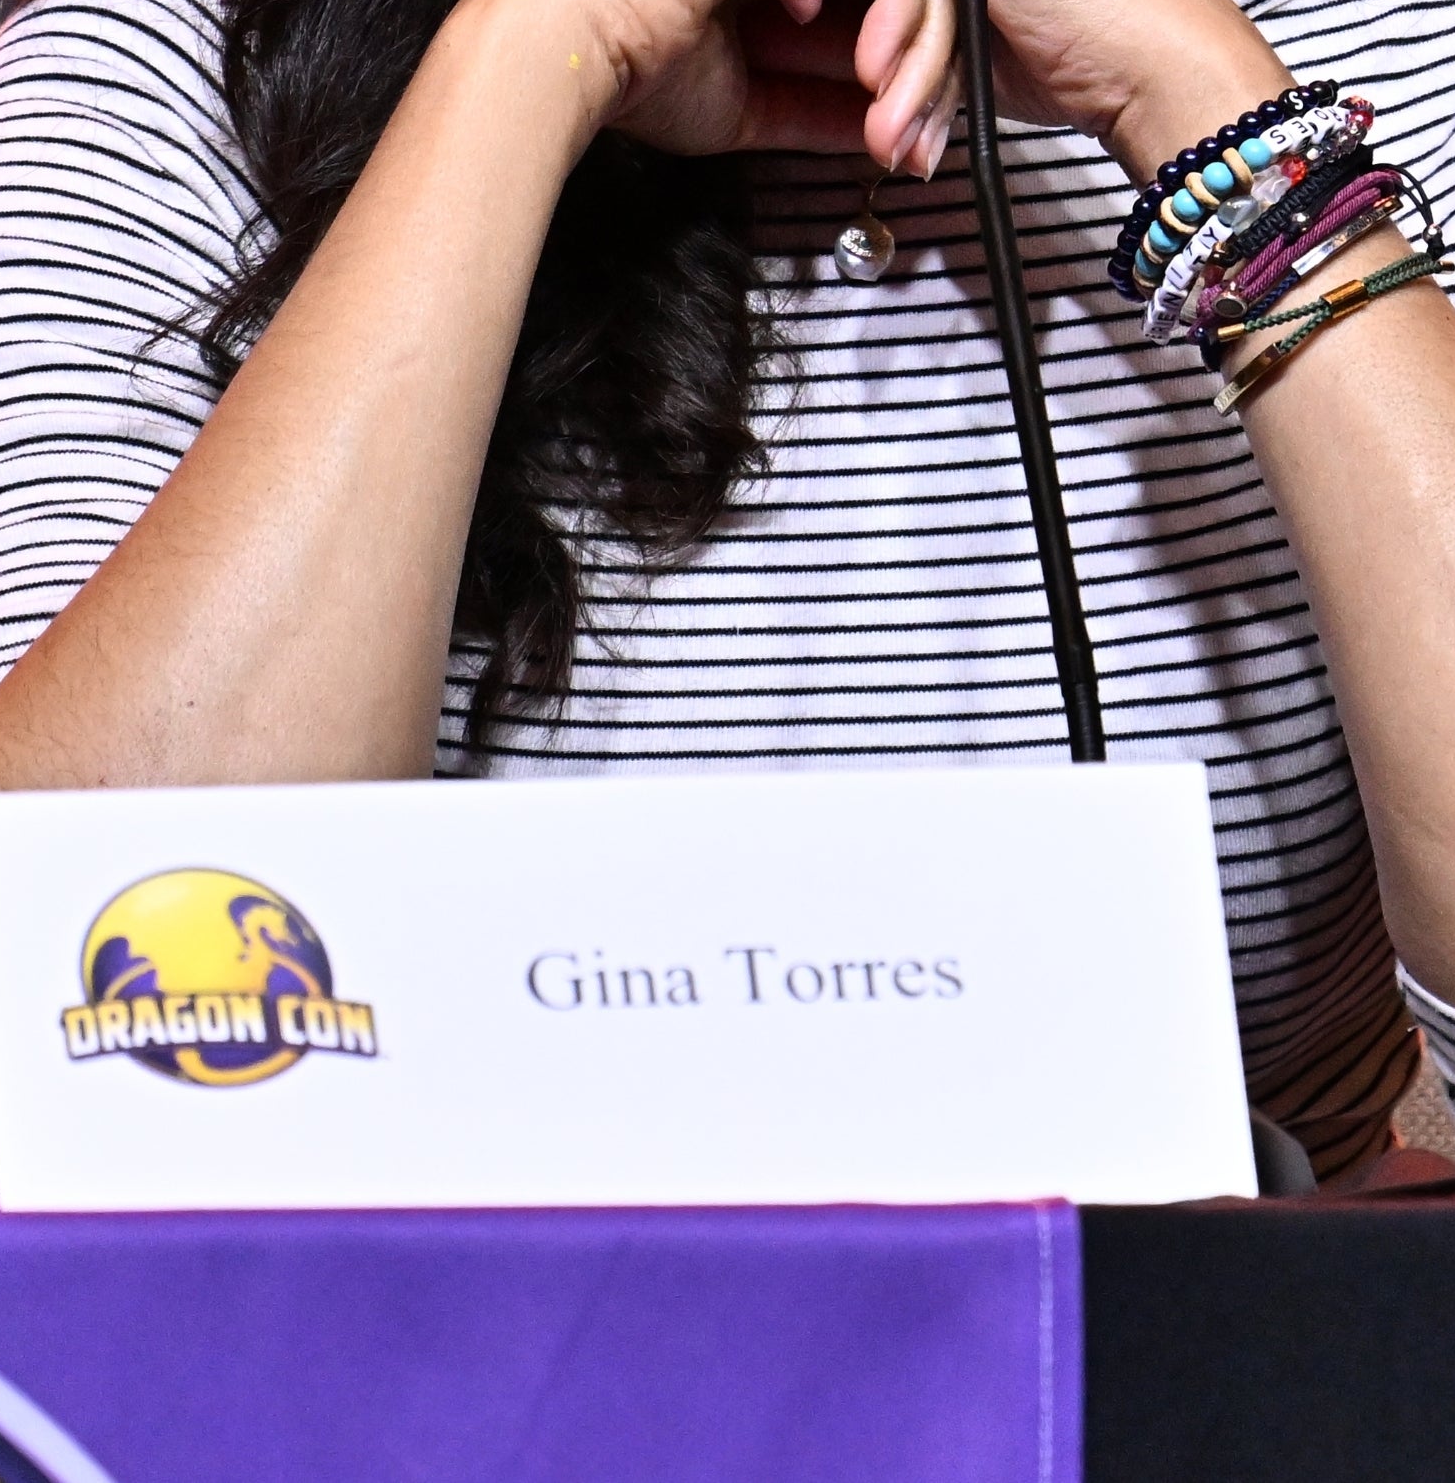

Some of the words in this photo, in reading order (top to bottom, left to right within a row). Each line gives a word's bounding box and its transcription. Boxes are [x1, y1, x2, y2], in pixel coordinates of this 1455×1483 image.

[526, 950, 702, 1011] Gina
[724, 945, 964, 1004] Torres
[61, 994, 267, 1060] DRAGON
[276, 994, 378, 1056] CON
